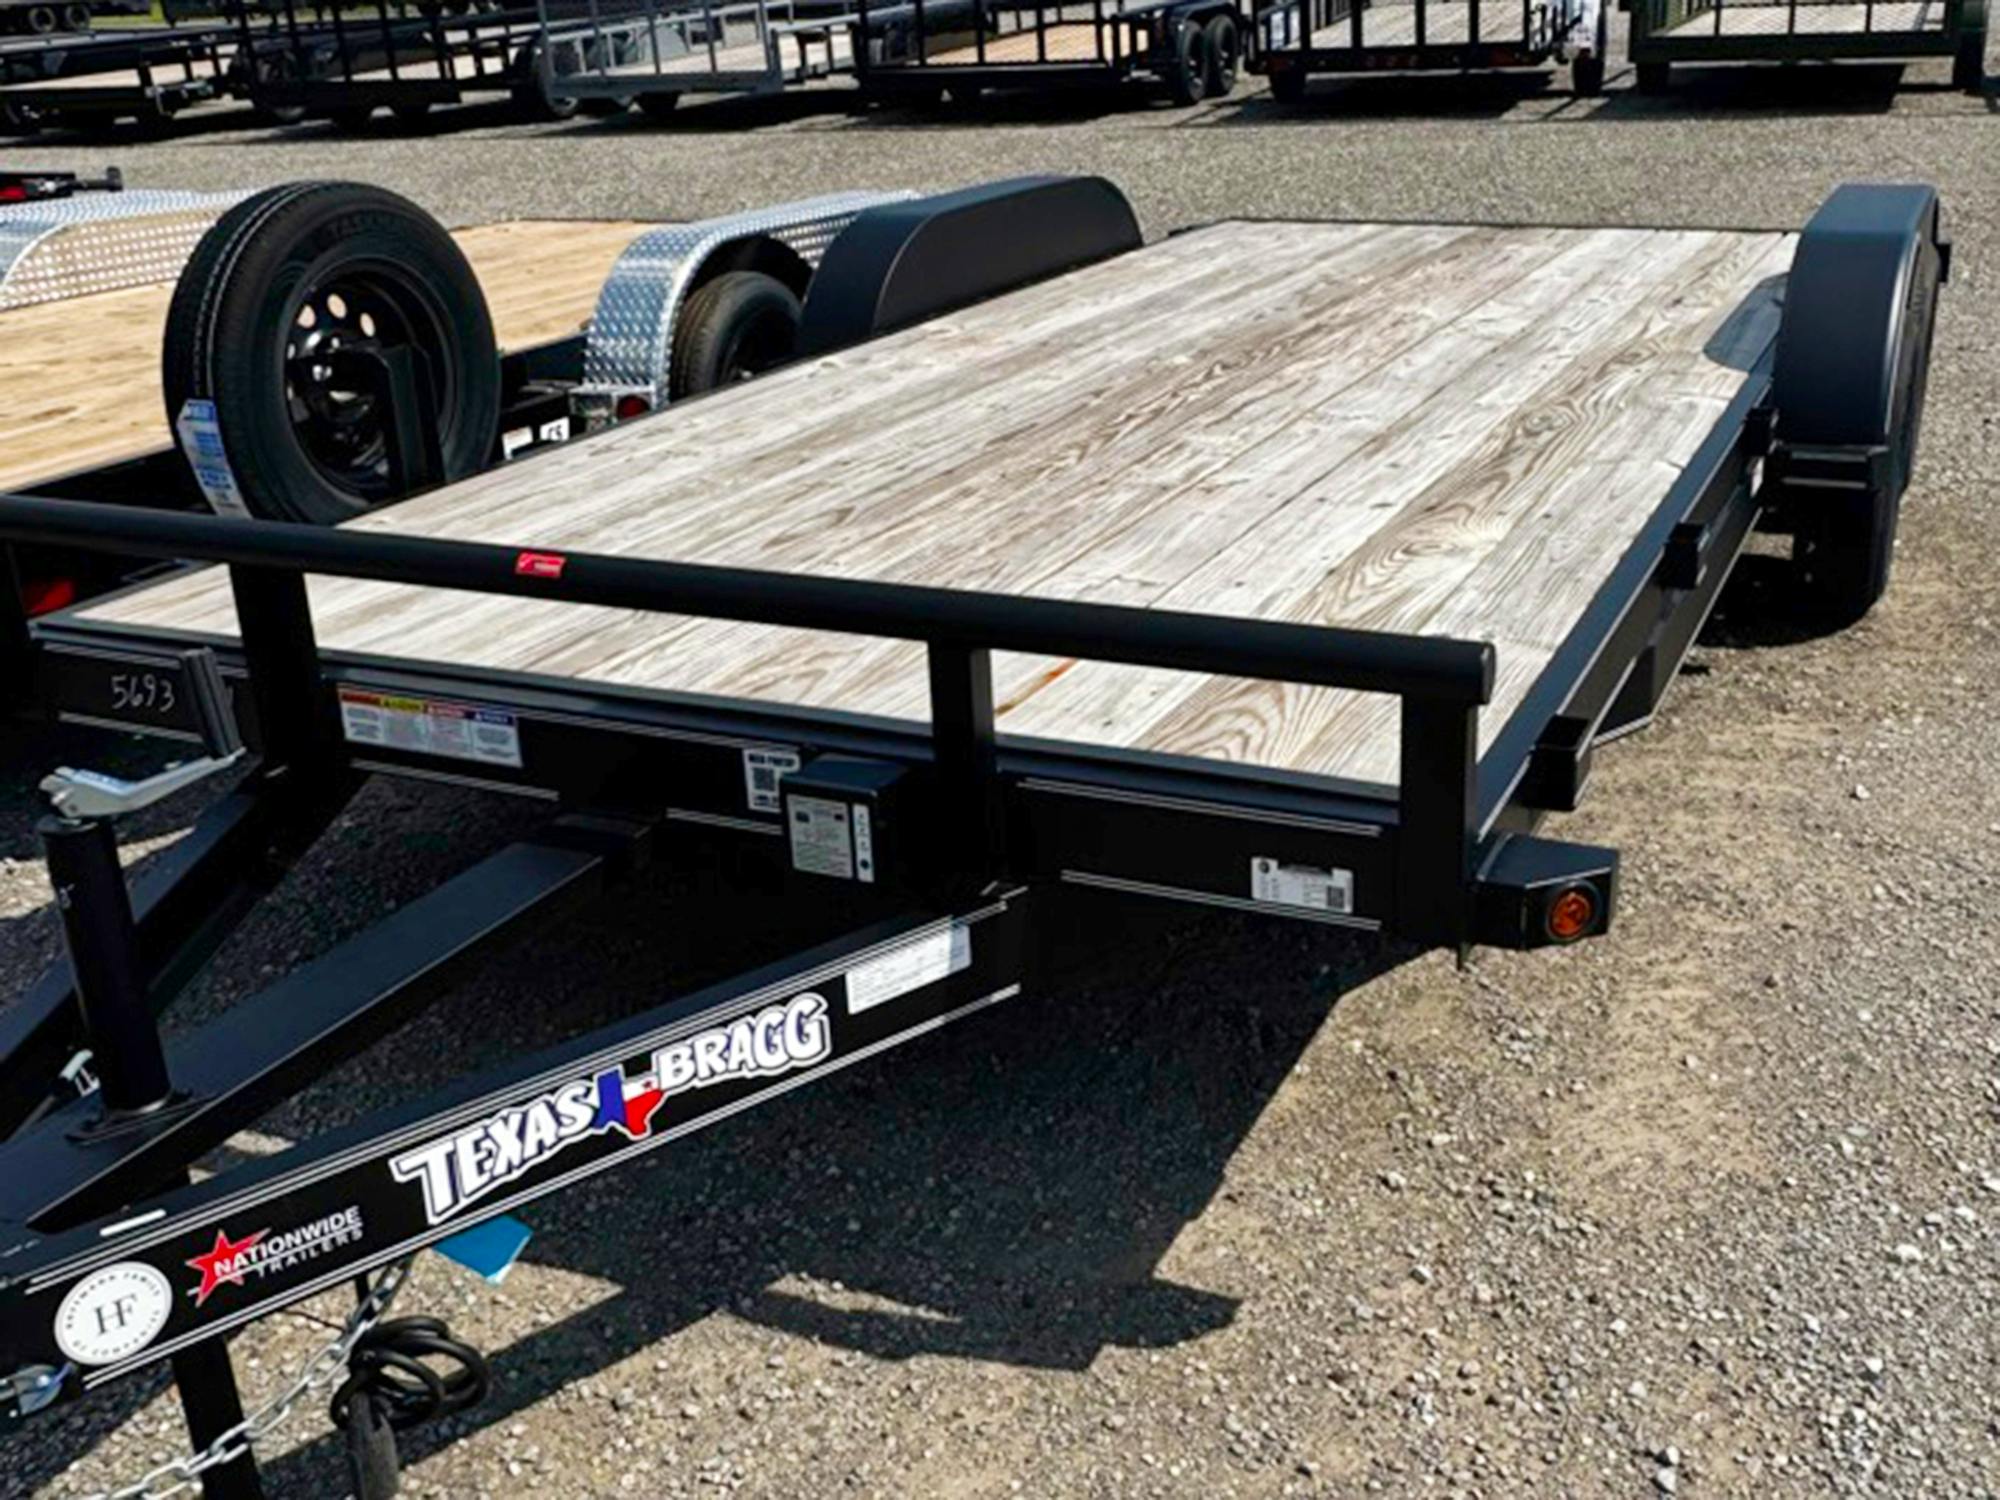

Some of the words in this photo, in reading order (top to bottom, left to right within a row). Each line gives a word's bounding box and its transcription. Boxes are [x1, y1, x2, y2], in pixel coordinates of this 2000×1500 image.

[111, 673, 175, 712] 5693
[389, 1079, 601, 1224] TEXAS
[652, 991, 830, 1094] BRAGG
[213, 1205, 360, 1277] NATIONWIDE
[255, 1228, 363, 1279] TRAILERS
[94, 1293, 138, 1337] HF
